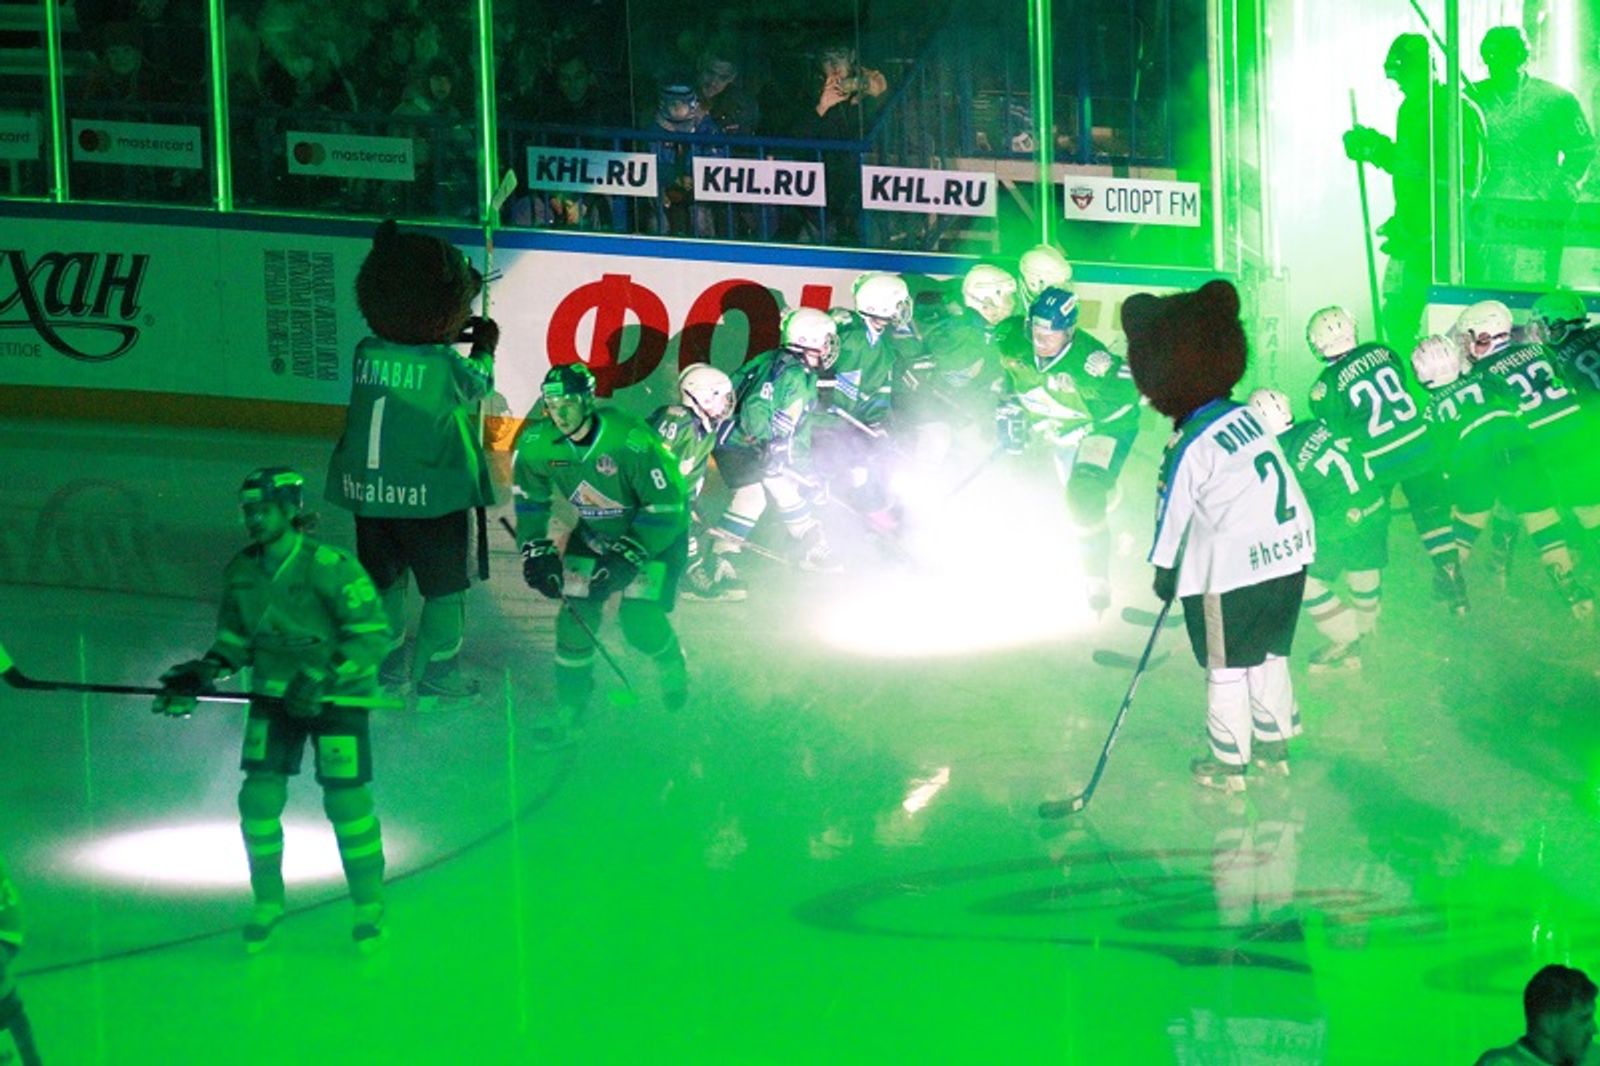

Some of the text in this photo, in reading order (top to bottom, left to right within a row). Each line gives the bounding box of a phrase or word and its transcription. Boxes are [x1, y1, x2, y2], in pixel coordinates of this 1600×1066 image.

[118, 137, 194, 152] mastercard
[332, 149, 407, 164] mastercard
[535, 155, 649, 188] KHL.RU
[702, 166, 816, 197] KHL.RU
[869, 174, 988, 207] KHL.RU
[1106, 188, 1197, 217] СПОРТ FM
[547, 273, 832, 397] ФО
[1349, 366, 1417, 438] 29
[366, 395, 387, 469] 1
[657, 419, 677, 440] 48
[650, 468, 666, 490] 8
[1254, 449, 1296, 525] 2
